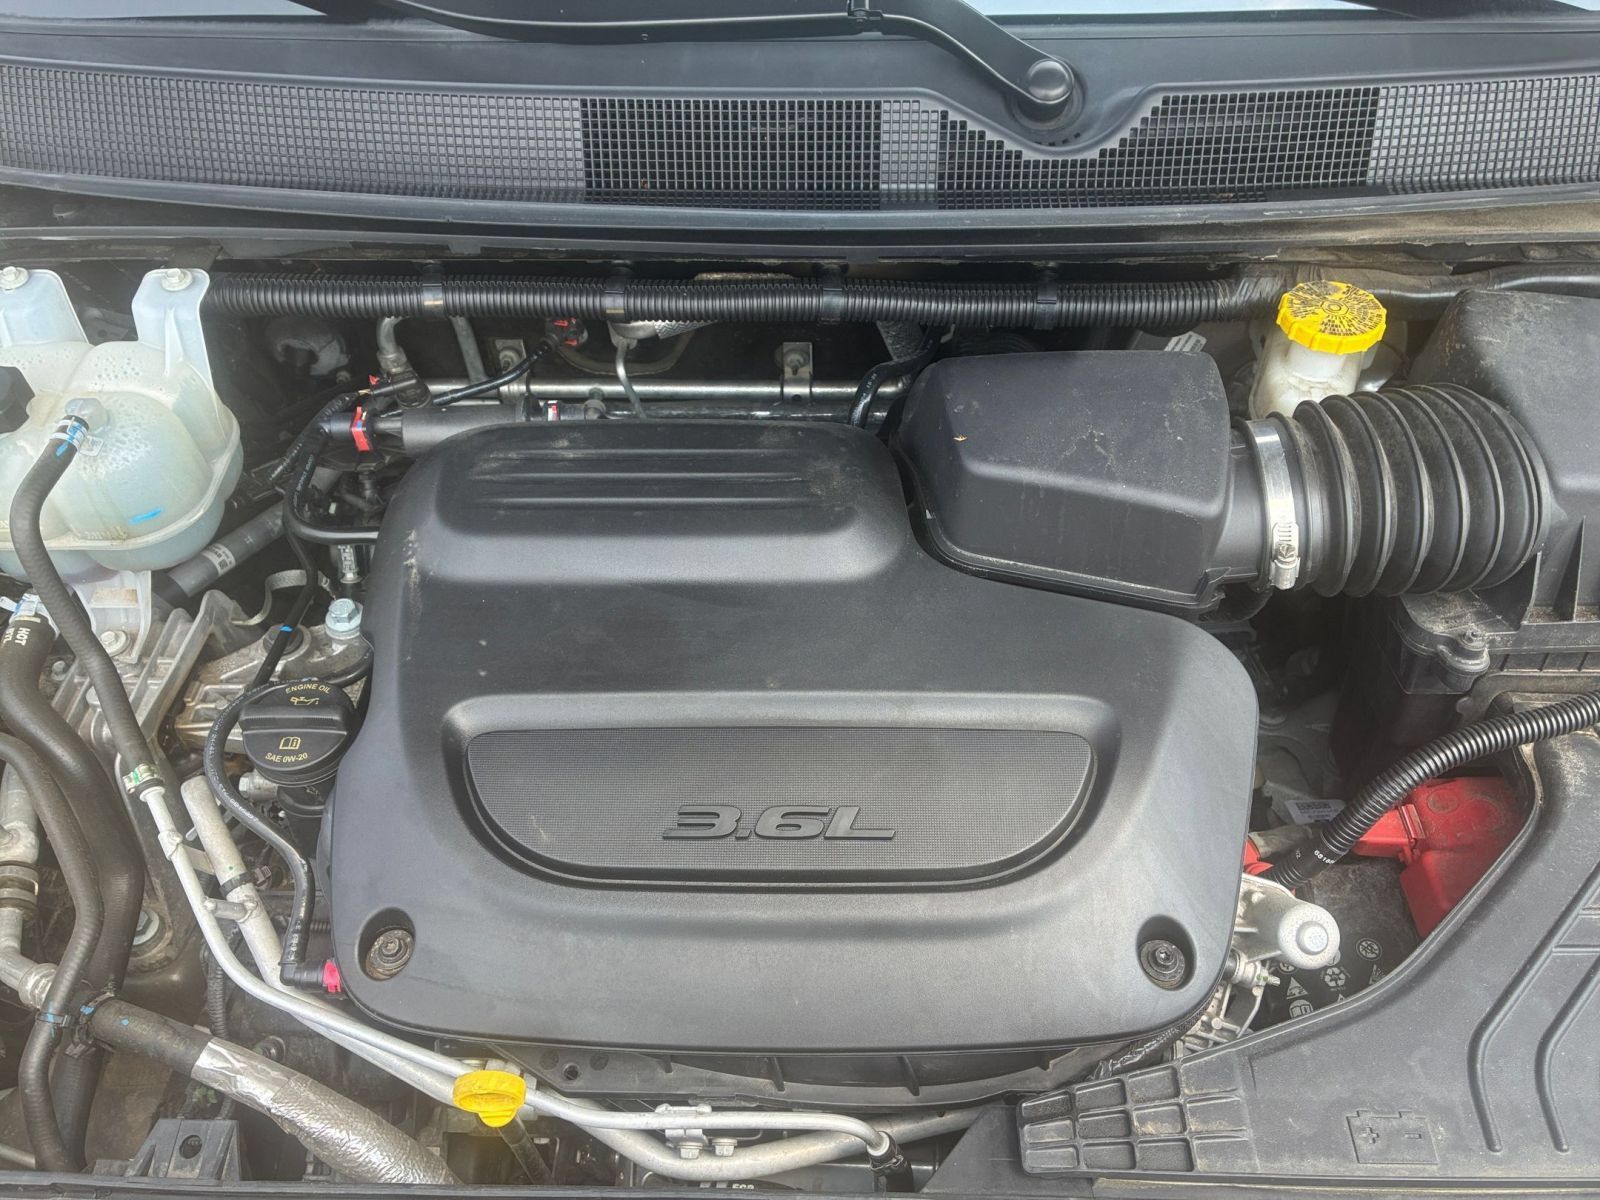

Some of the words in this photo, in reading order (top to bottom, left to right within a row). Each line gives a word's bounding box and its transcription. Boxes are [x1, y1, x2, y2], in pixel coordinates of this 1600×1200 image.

[15, 627, 31, 646] HOT
[285, 683, 318, 694] ENGINE
[318, 684, 331, 694] OIL
[265, 752, 282, 763] SAE
[282, 752, 308, 763] 0W-20
[662, 804, 896, 841] 3.6L
